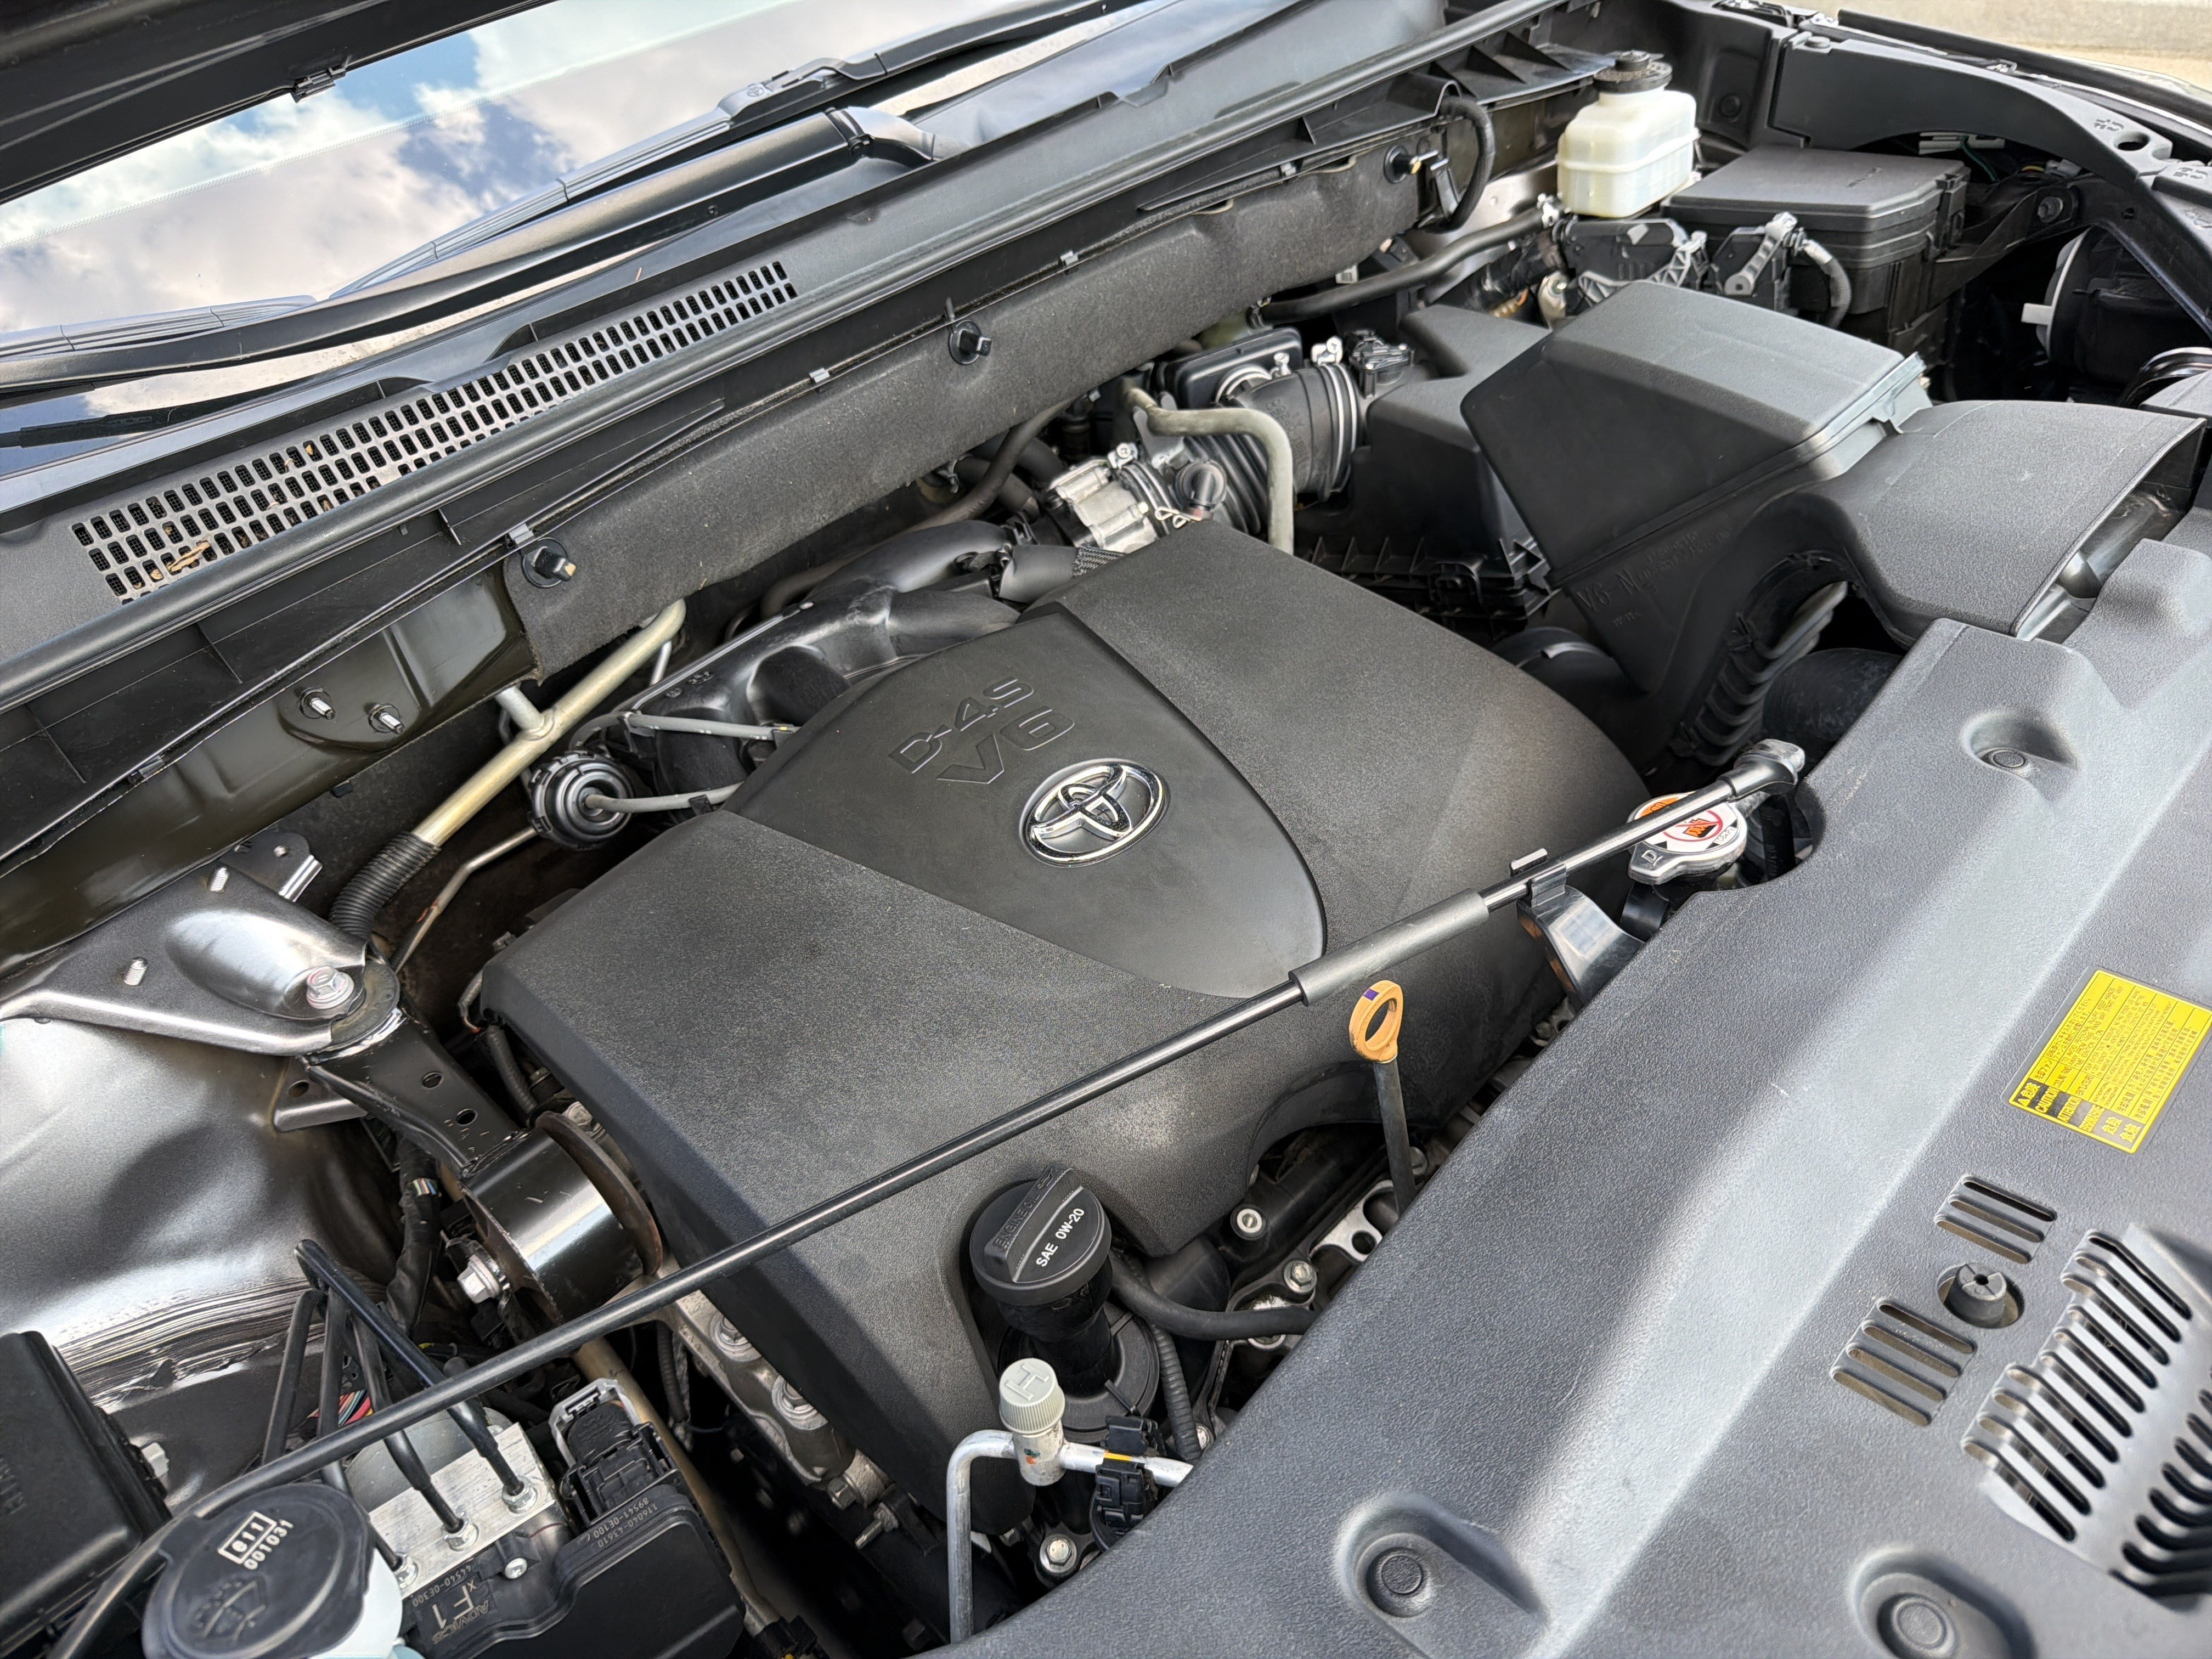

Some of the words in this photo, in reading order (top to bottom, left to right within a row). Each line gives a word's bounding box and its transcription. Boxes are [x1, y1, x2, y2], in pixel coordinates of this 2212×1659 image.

[889, 676, 1035, 774] D-4S
[936, 706, 1075, 784] V6
[2034, 1086, 2060, 1114] CAUTION
[2056, 1094, 2082, 1122] ATTENTION
[995, 1208, 1028, 1246] ENGINE
[1023, 1193, 1041, 1209] OIL
[1035, 1241, 1059, 1268] SAE
[1054, 1206, 1086, 1241] 0W-20
[1005, 1363, 1049, 1401] H
[231, 1522, 264, 1553] e11
[243, 1518, 294, 1570] 001031
[431, 1599, 491, 1645] ADVICS
